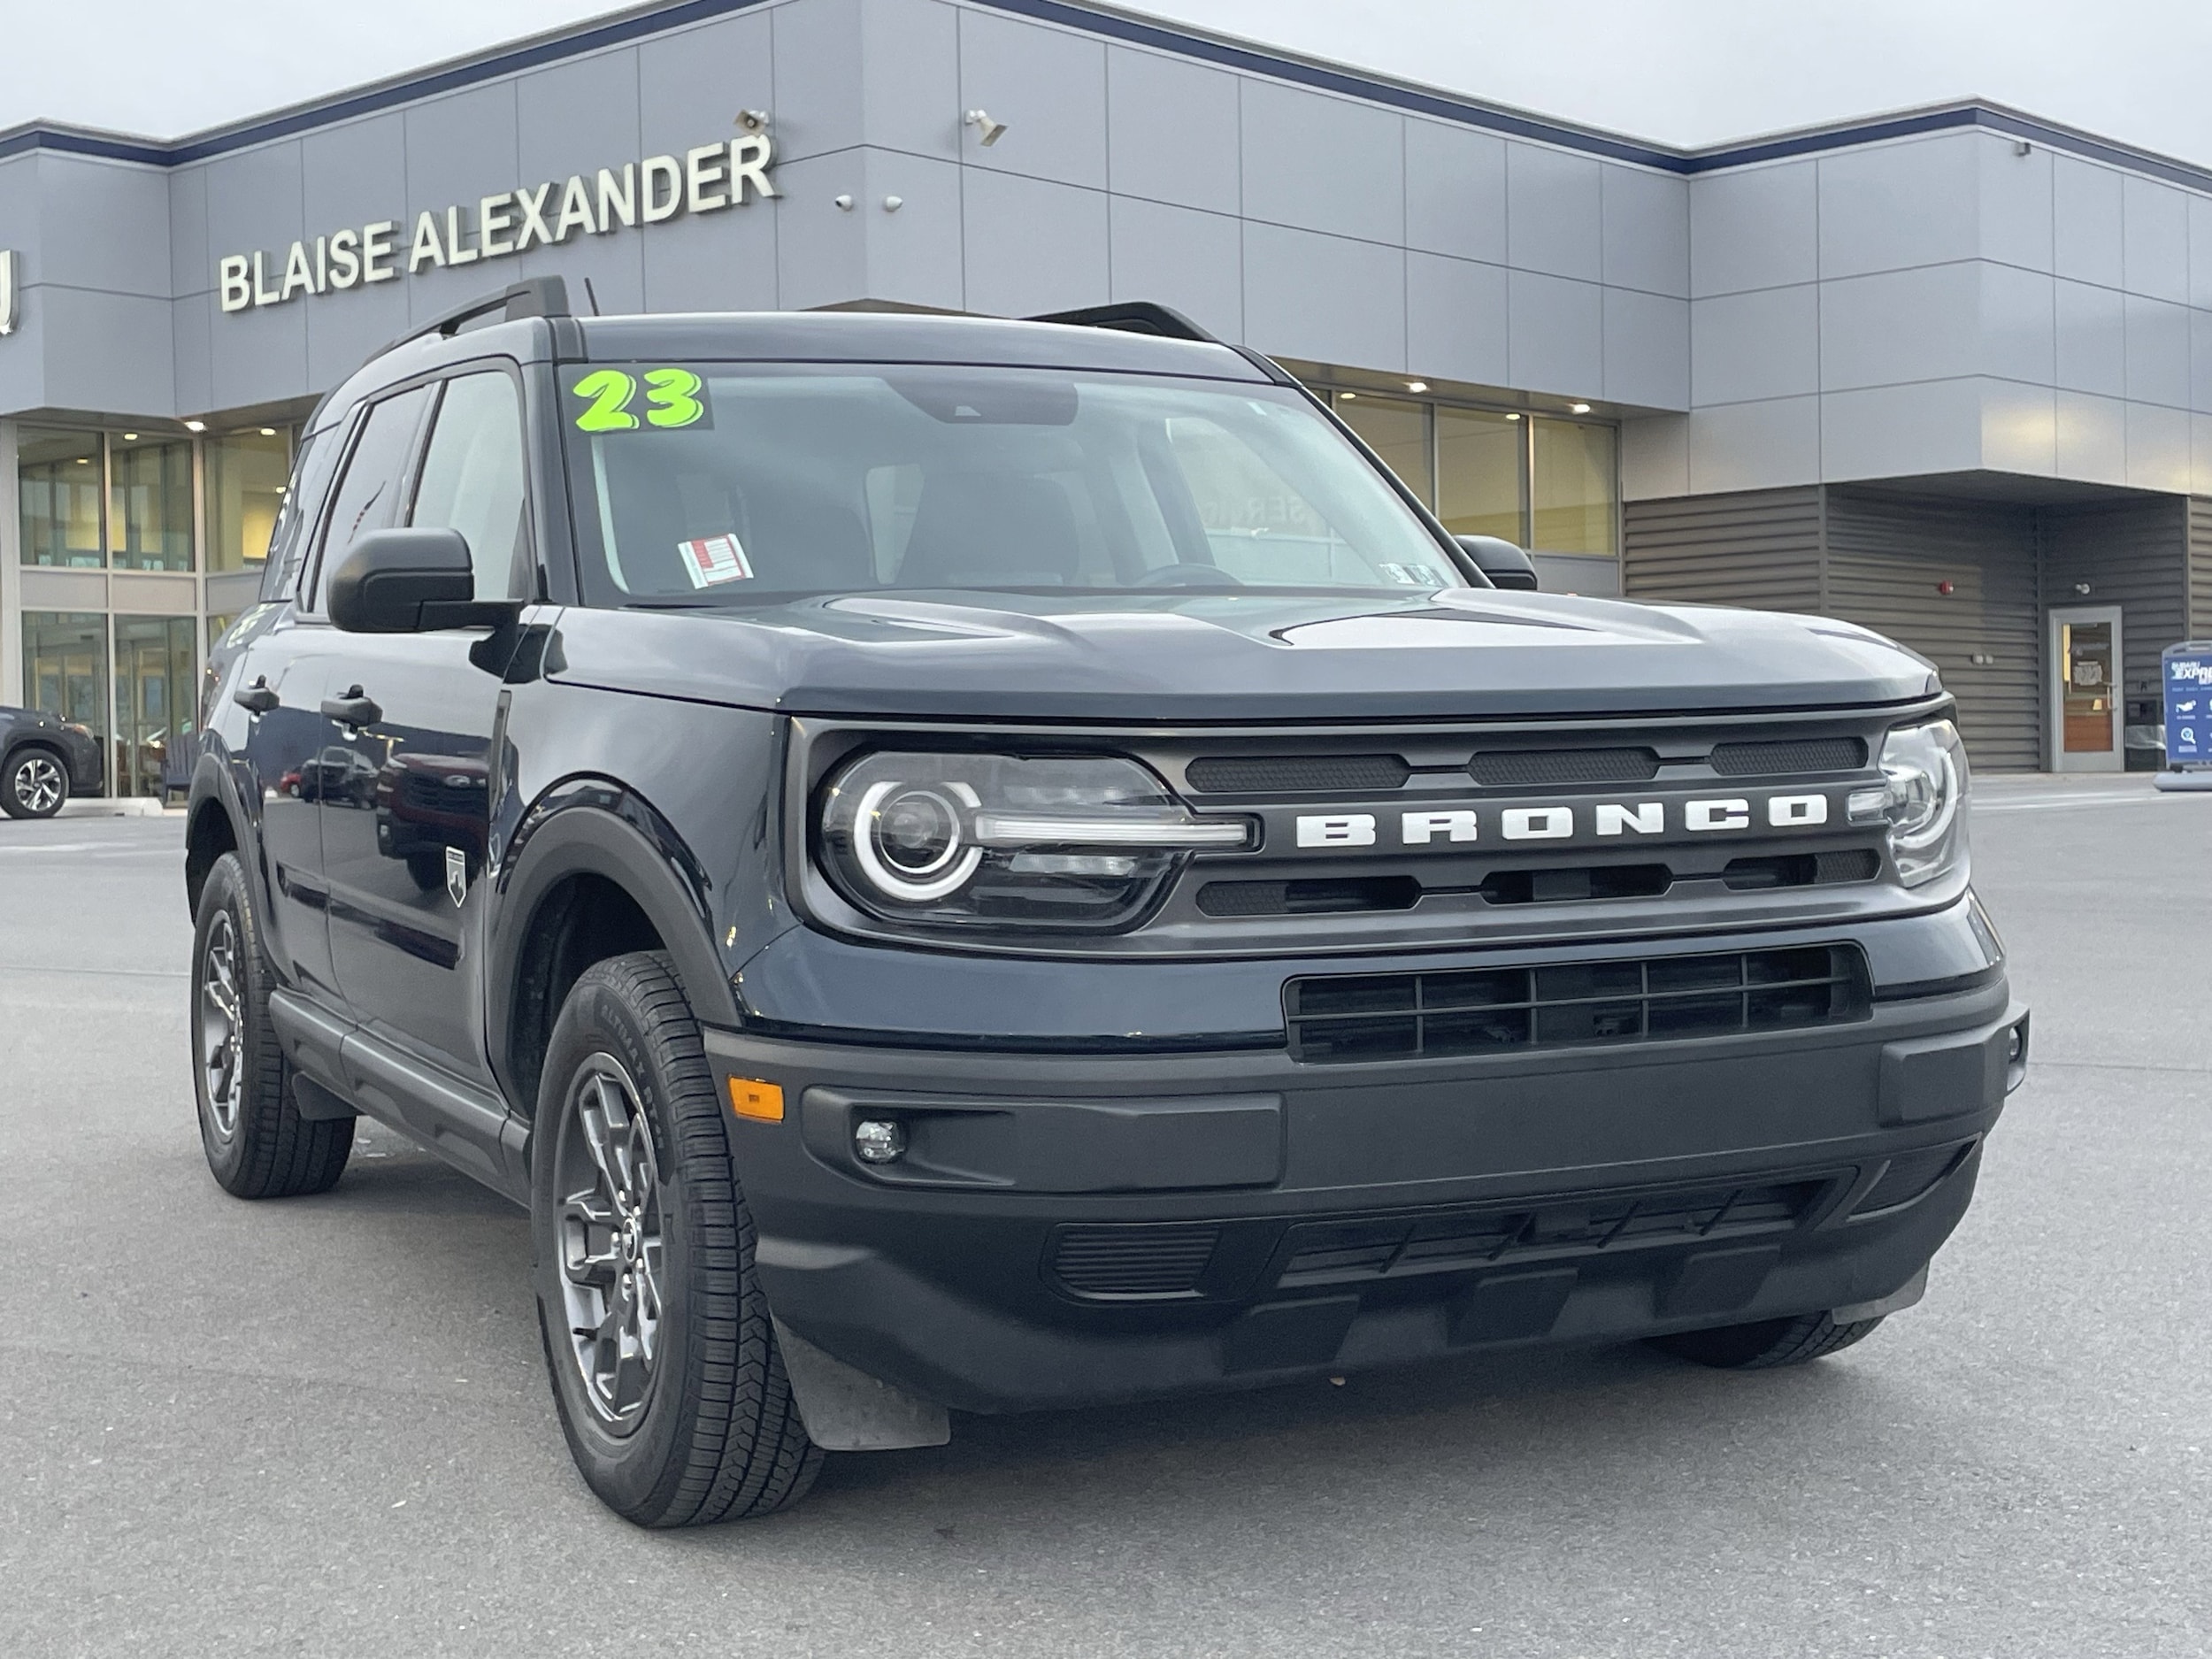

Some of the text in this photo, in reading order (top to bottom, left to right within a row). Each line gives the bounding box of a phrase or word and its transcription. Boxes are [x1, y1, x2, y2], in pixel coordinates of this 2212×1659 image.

[220, 134, 780, 313] BLAISE ALEXANDER
[573, 369, 704, 432] 23
[1295, 795, 1828, 848] BRONCO
[601, 1003, 645, 1079] ALTIMAX
